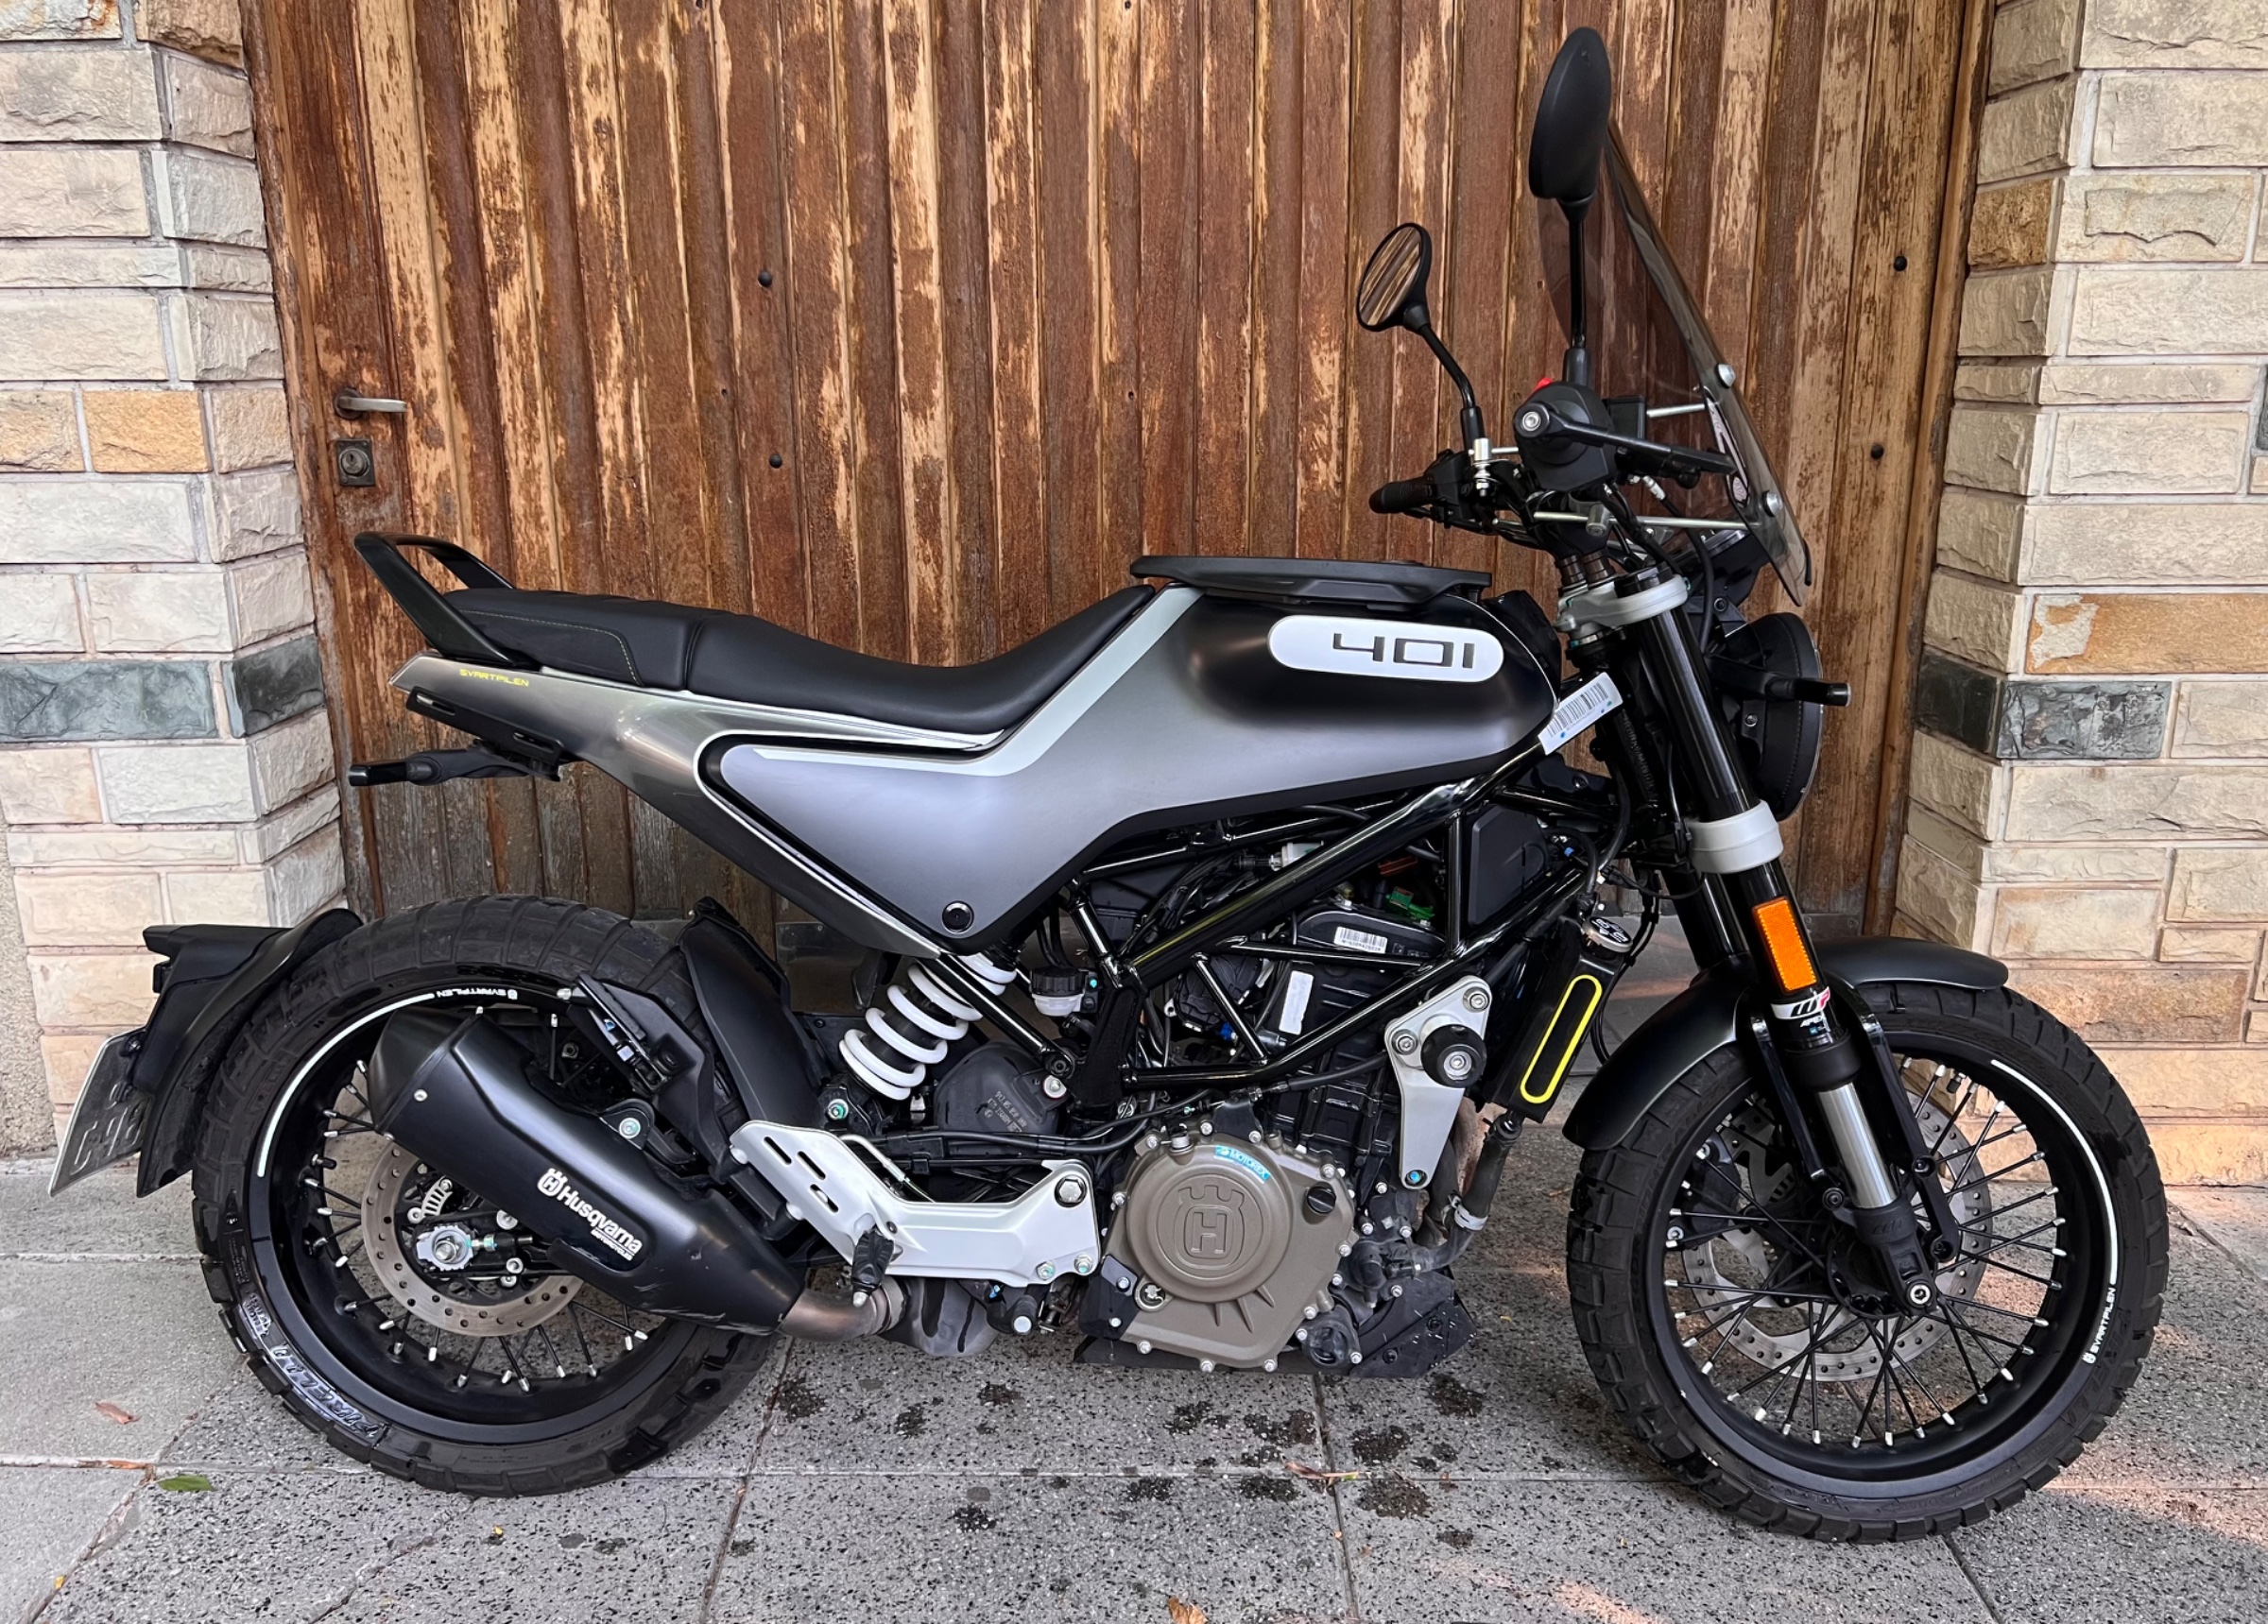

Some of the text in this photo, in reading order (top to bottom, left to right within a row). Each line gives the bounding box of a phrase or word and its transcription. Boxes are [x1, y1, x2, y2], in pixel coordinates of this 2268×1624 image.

[1332, 632, 1475, 669] 401
[459, 668, 529, 687] SVARTPILEN
[557, 1185, 643, 1255] Husqvarna
